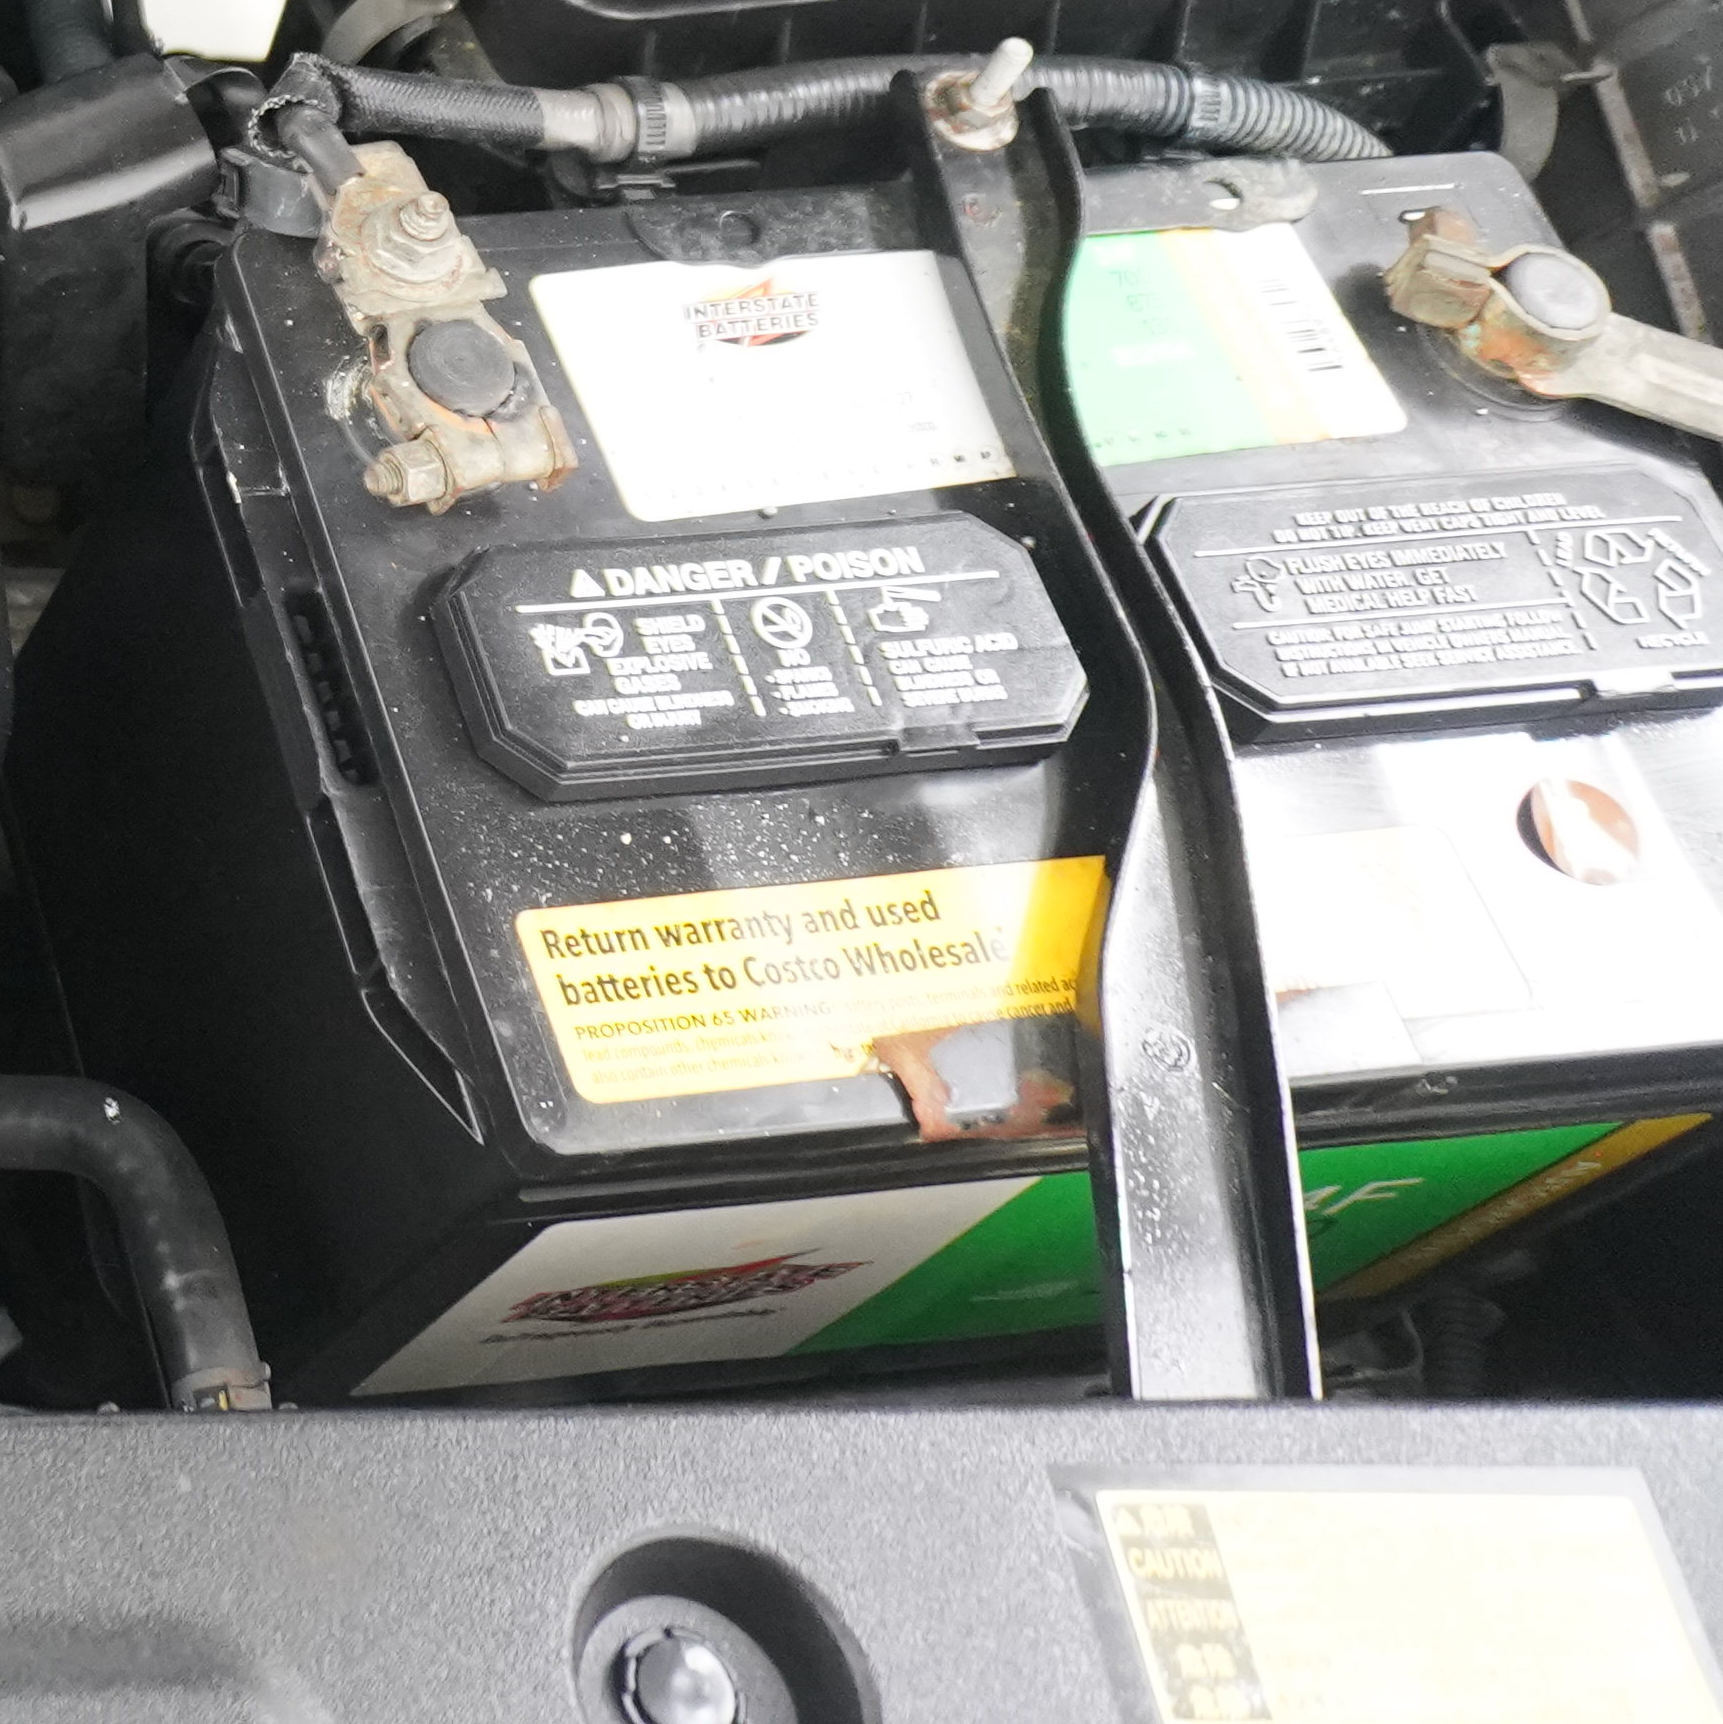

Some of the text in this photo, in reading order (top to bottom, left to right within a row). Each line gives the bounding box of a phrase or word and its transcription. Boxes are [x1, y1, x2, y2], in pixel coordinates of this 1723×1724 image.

[684, 293, 820, 320] INTERSTATE
[699, 312, 819, 338] BATTERIES
[1294, 511, 1333, 526] KEEP
[1334, 508, 1366, 523] OUT
[1387, 503, 1420, 519] THE
[1418, 500, 1469, 517] REACH
[1490, 492, 1567, 511] CHILDREN
[1296, 526, 1329, 542] NOT
[1360, 521, 1399, 536] KEEP
[1398, 518, 1440, 533] VENT
[1439, 515, 1481, 531] CAPS
[1524, 508, 1559, 523] AND
[1556, 505, 1606, 521] LEVEL
[603, 559, 758, 596] DANGER
[786, 546, 925, 583] POISON
[1284, 540, 1508, 576] FLUSH EYES IMMEDIATELY
[1295, 574, 1346, 595] WITH
[1414, 567, 1451, 586] GET
[1305, 584, 1479, 614] MEDICAL HELP FAST
[634, 614, 706, 635] SHIELD
[1363, 622, 1399, 639] SAFE
[1436, 613, 1504, 632] STARTING
[641, 634, 696, 654] EYES
[777, 648, 811, 667] NO
[878, 632, 1018, 660] SULFURIC ACID
[606, 652, 713, 676] EXPLOSIVE
[888, 655, 973, 675] CAN CAUSE
[614, 673, 682, 695] GASES
[540, 889, 942, 960] Return warranty and used
[556, 932, 1010, 1005] batteries to Costco Wholesale
[575, 1013, 707, 1040] PROPOSITION
[713, 1010, 735, 1027] 65
[1015, 975, 1059, 996] related
[1007, 1000, 1048, 1020] cancer
[1049, 997, 1073, 1015] and
[1127, 1546, 1228, 1580] CAUTION
